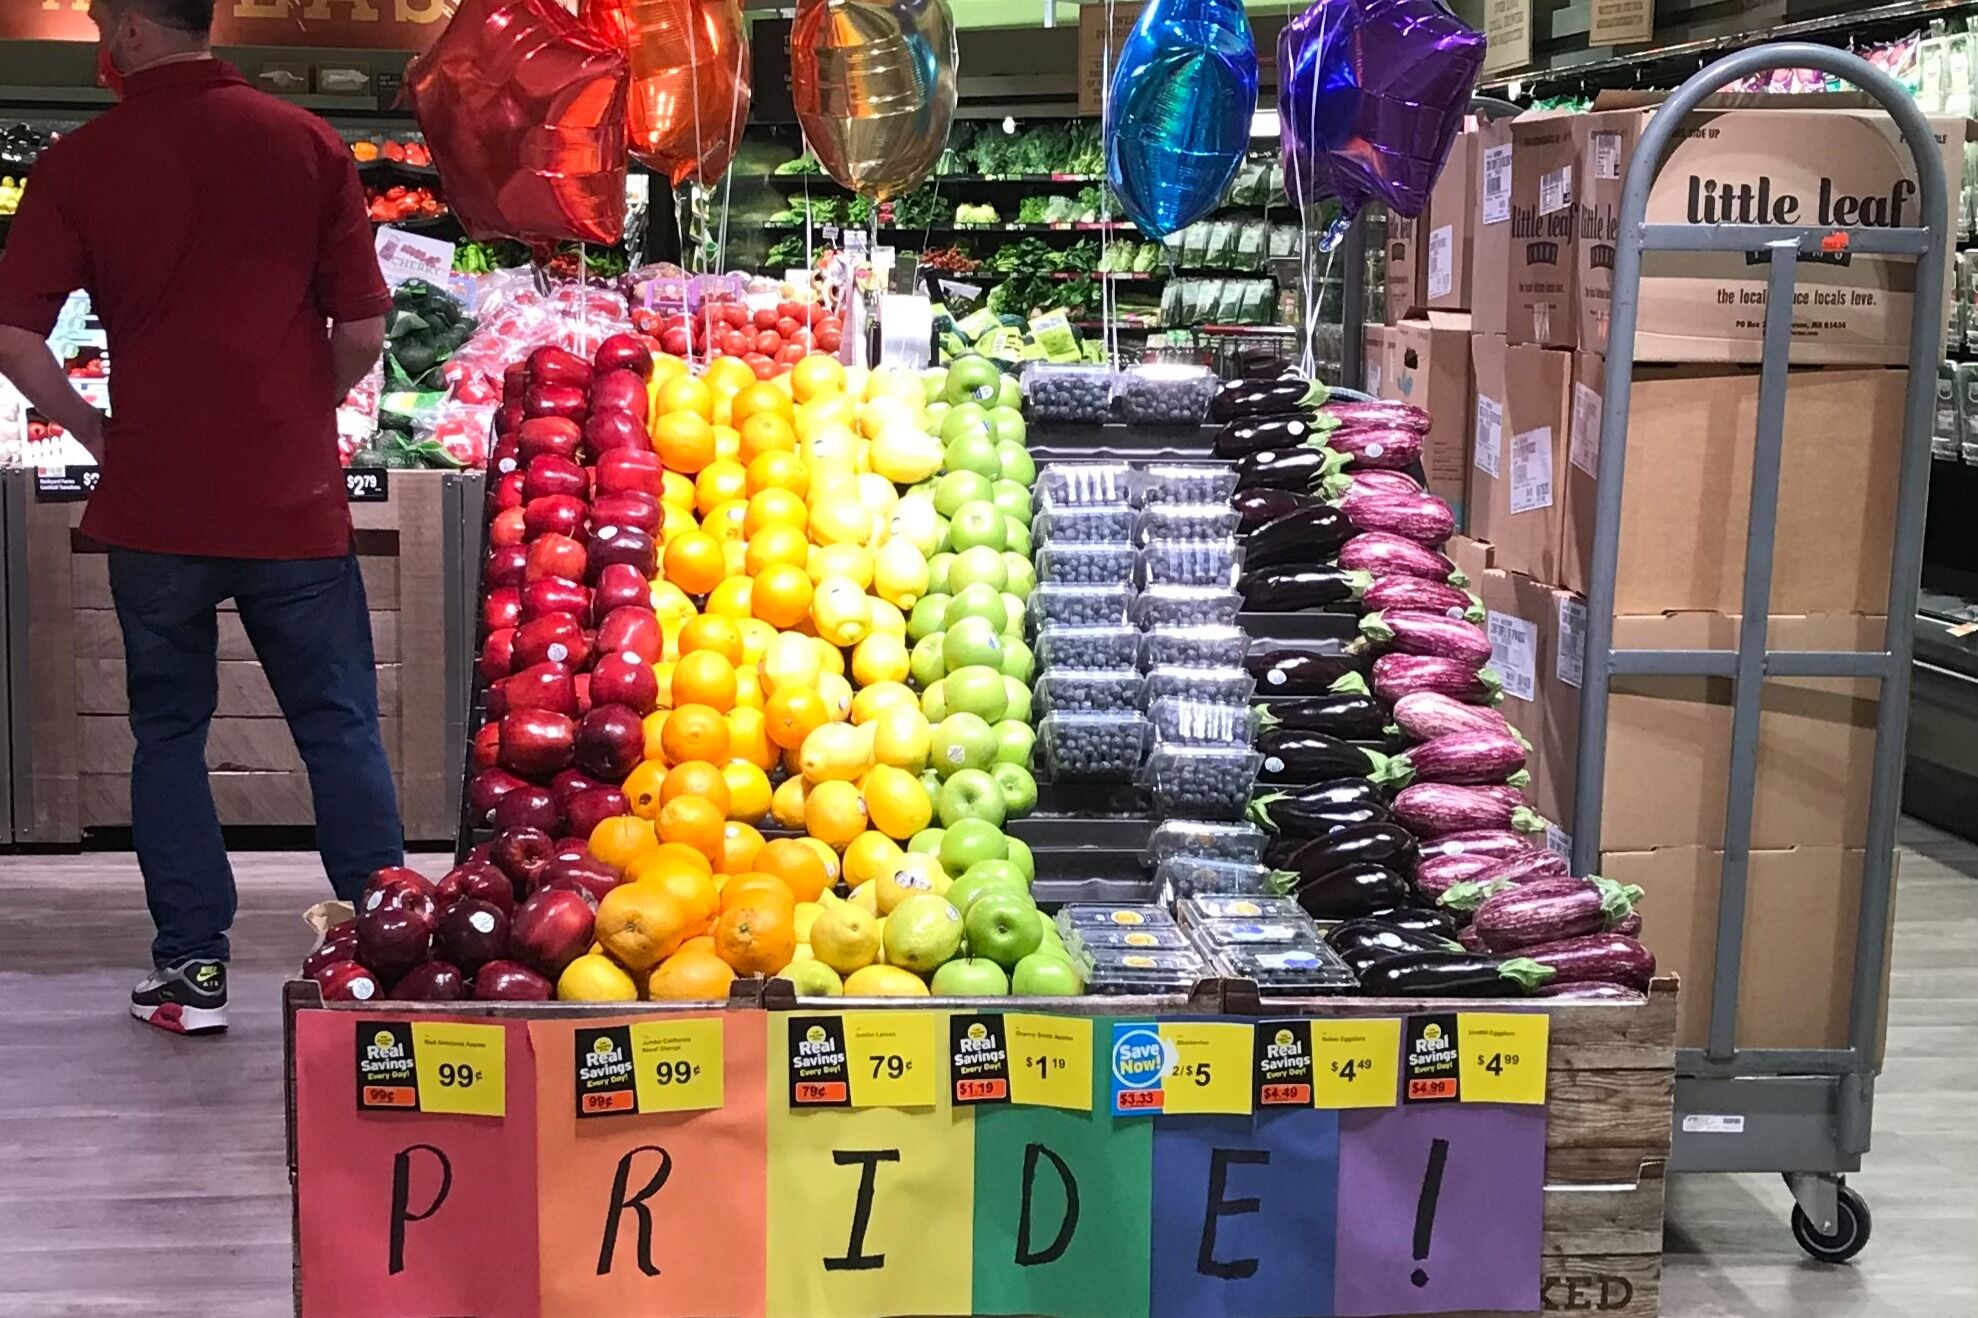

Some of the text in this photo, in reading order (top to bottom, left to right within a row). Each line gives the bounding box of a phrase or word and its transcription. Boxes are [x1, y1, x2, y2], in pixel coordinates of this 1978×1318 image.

[1708, 129, 1721, 139] UP
[1687, 174, 1917, 228] little leaf
[1511, 201, 1579, 246] little leaf
[1580, 203, 1617, 240] little le
[391, 256, 441, 276] CHERRY
[1717, 288, 1767, 304] the local
[1814, 289, 1847, 306] locals
[1850, 290, 1877, 306] love.
[366, 1043, 404, 1060] Real
[798, 1036, 836, 1056] Real
[959, 1034, 997, 1054] Real
[1119, 1043, 1160, 1061] Save
[1266, 1039, 1302, 1059] Real
[1415, 1033, 1449, 1054] Real
[360, 1057, 414, 1072] Savings
[585, 1046, 623, 1067] Real
[792, 1051, 845, 1069] Savings
[954, 1049, 1006, 1066] Savings
[1260, 1054, 1311, 1072] Savings
[1408, 1049, 1457, 1066] Savings
[579, 1060, 633, 1080] Savings
[656, 1060, 701, 1085] 99¢
[799, 1064, 841, 1077] Every Day!
[869, 1054, 913, 1079] 79¢
[960, 1062, 1002, 1075] Every Day!
[1119, 1055, 1161, 1076] Now!
[1266, 1066, 1307, 1080] Every Day!
[1414, 1060, 1453, 1074] Every Day!
[367, 1070, 410, 1080] Every Day!
[438, 1063, 483, 1088] 99¢
[586, 1073, 629, 1089] Every Day!
[802, 1085, 826, 1098] 79¢
[959, 1082, 994, 1096] $1.19
[1263, 1086, 1298, 1100] $4.49
[1412, 1081, 1446, 1095] $4.99
[1119, 1092, 1154, 1106] $3.33
